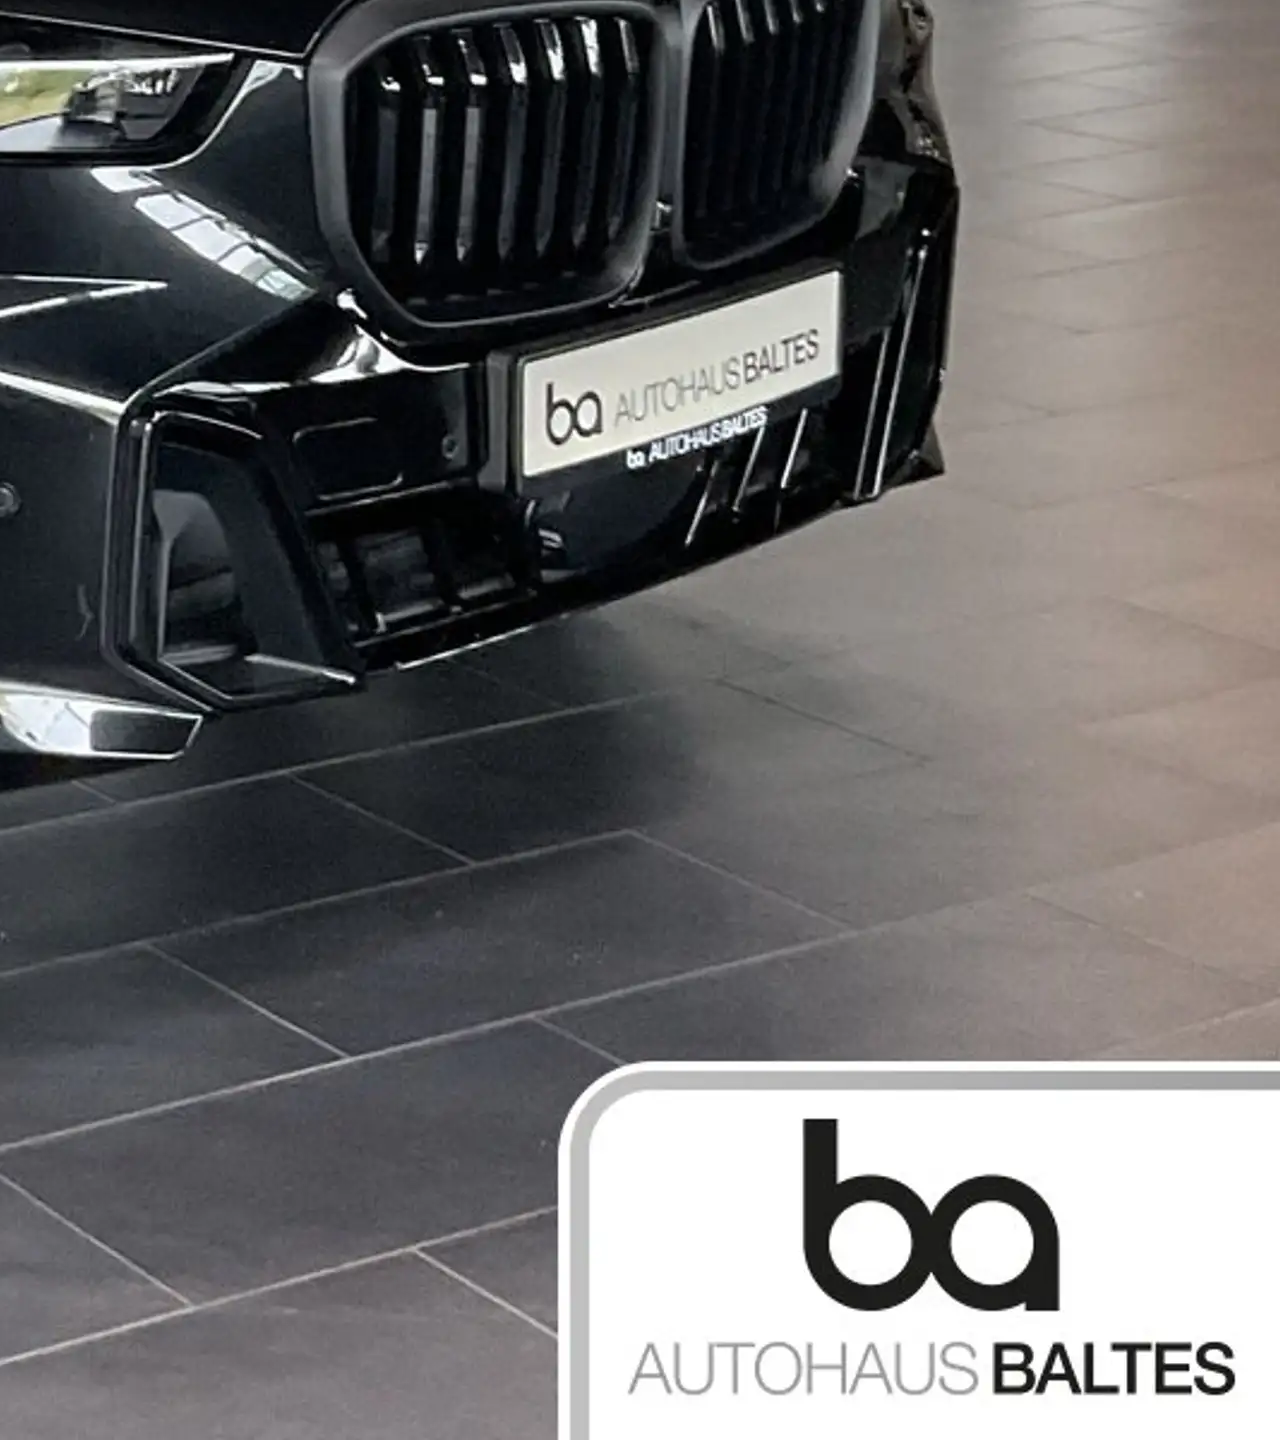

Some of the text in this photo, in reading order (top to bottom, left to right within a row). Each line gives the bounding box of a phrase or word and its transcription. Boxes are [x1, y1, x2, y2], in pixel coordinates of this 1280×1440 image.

[546, 329, 819, 445] ba AUTOHAUS BALTES
[649, 422, 720, 462] AUTOHAUS
[721, 406, 767, 438] BALTES
